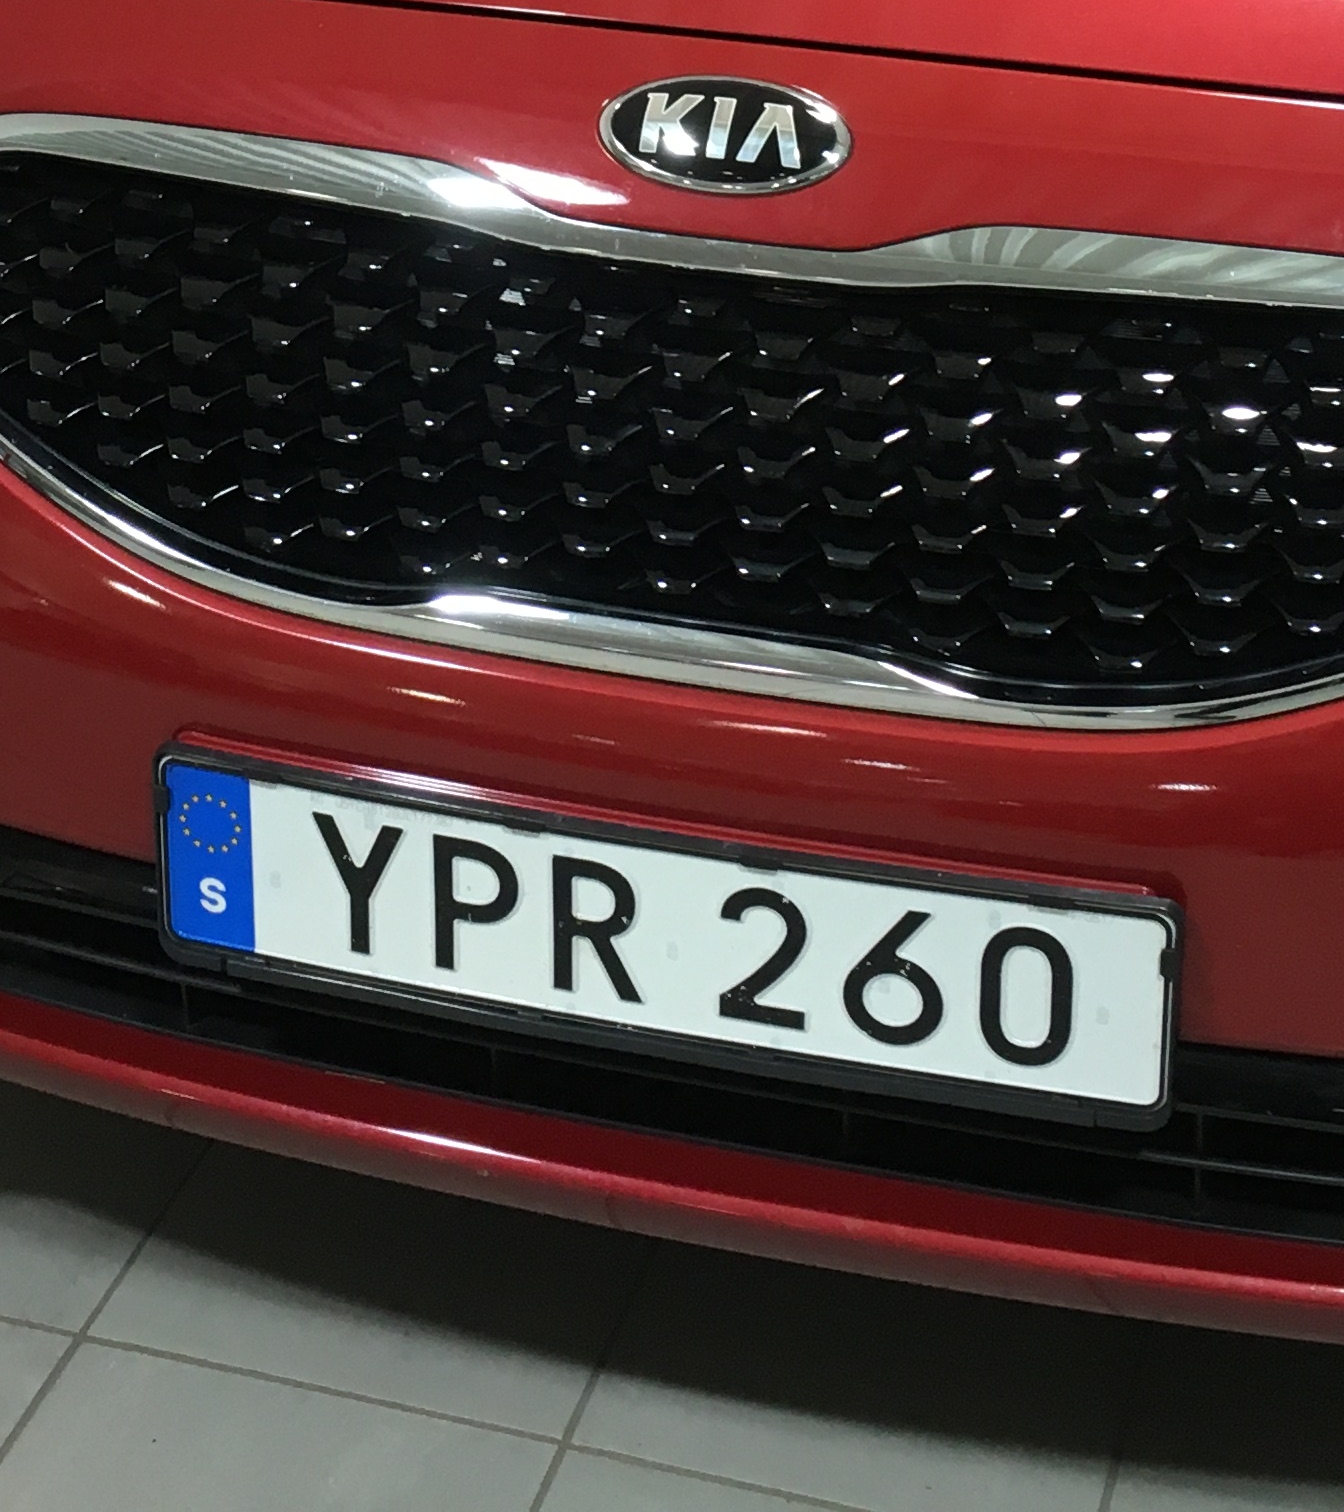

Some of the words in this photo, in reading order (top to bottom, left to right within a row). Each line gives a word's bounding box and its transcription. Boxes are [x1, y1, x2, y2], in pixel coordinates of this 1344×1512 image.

[639, 92, 801, 169] KIA
[199, 877, 227, 914] S
[311, 811, 643, 1004] YPR
[718, 887, 1074, 1067] 260
